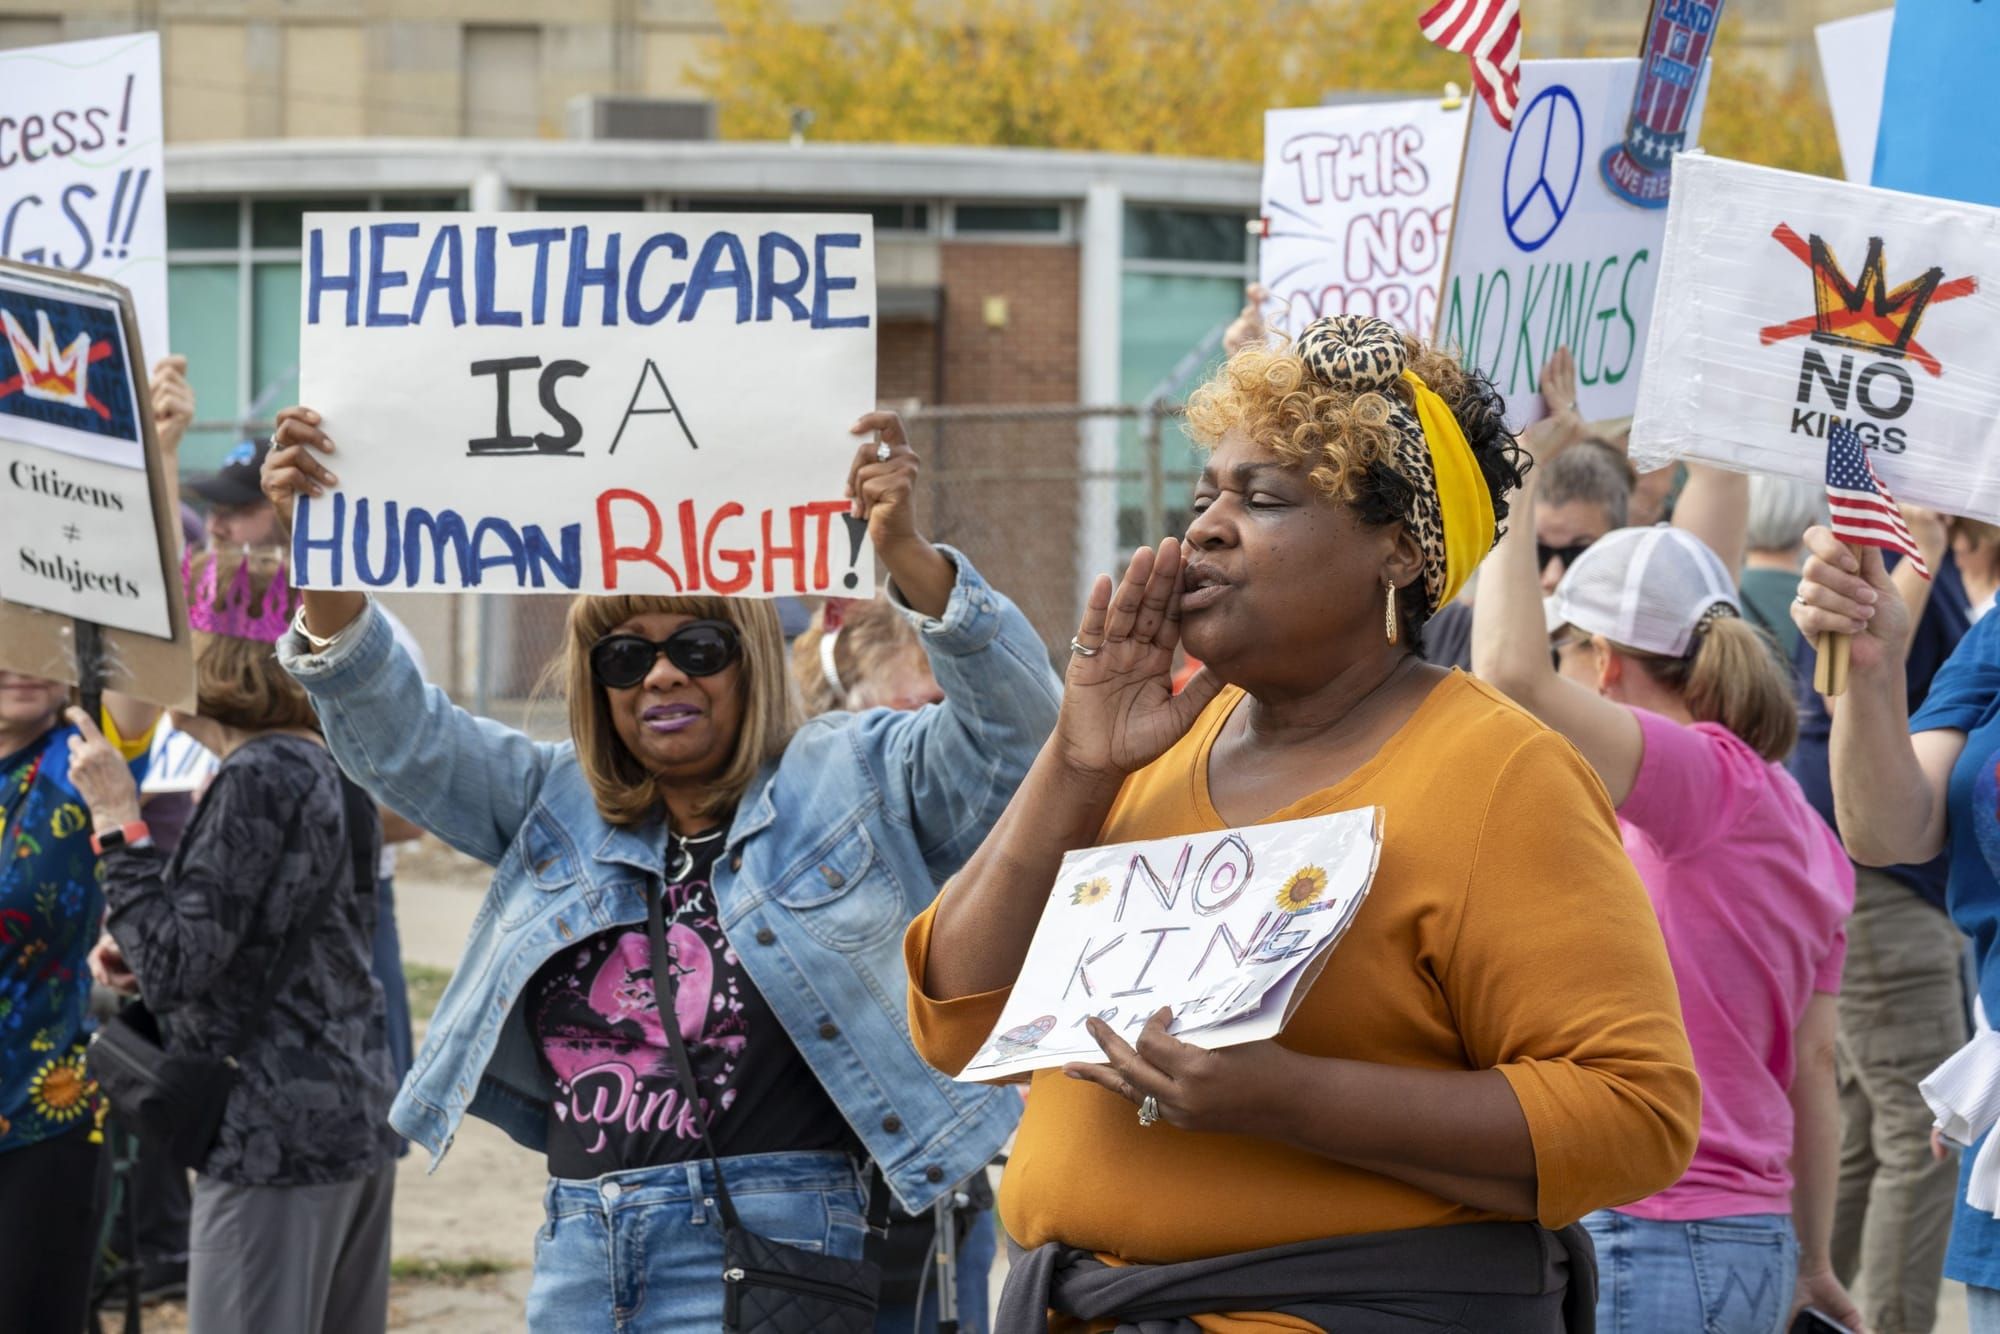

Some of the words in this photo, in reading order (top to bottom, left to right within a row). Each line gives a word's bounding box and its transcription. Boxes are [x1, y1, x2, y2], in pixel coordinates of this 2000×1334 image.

[1281, 124, 1430, 204] THIS
[1612, 150, 1641, 193] LIVE
[1, 167, 152, 272] GS!!
[1344, 203, 1452, 283] NO
[307, 222, 870, 329] HEALTHCARE
[1445, 268, 1511, 382] NO
[1508, 248, 1649, 396] KINGS
[466, 355, 590, 453] IS
[609, 358, 699, 455] A
[1796, 347, 1915, 420] NO
[9, 459, 125, 512] Citizens
[19, 547, 140, 600] Subjects
[293, 492, 582, 589] HUMAN
[596, 488, 868, 595] RIGHT!
[1113, 831, 1253, 923] NO
